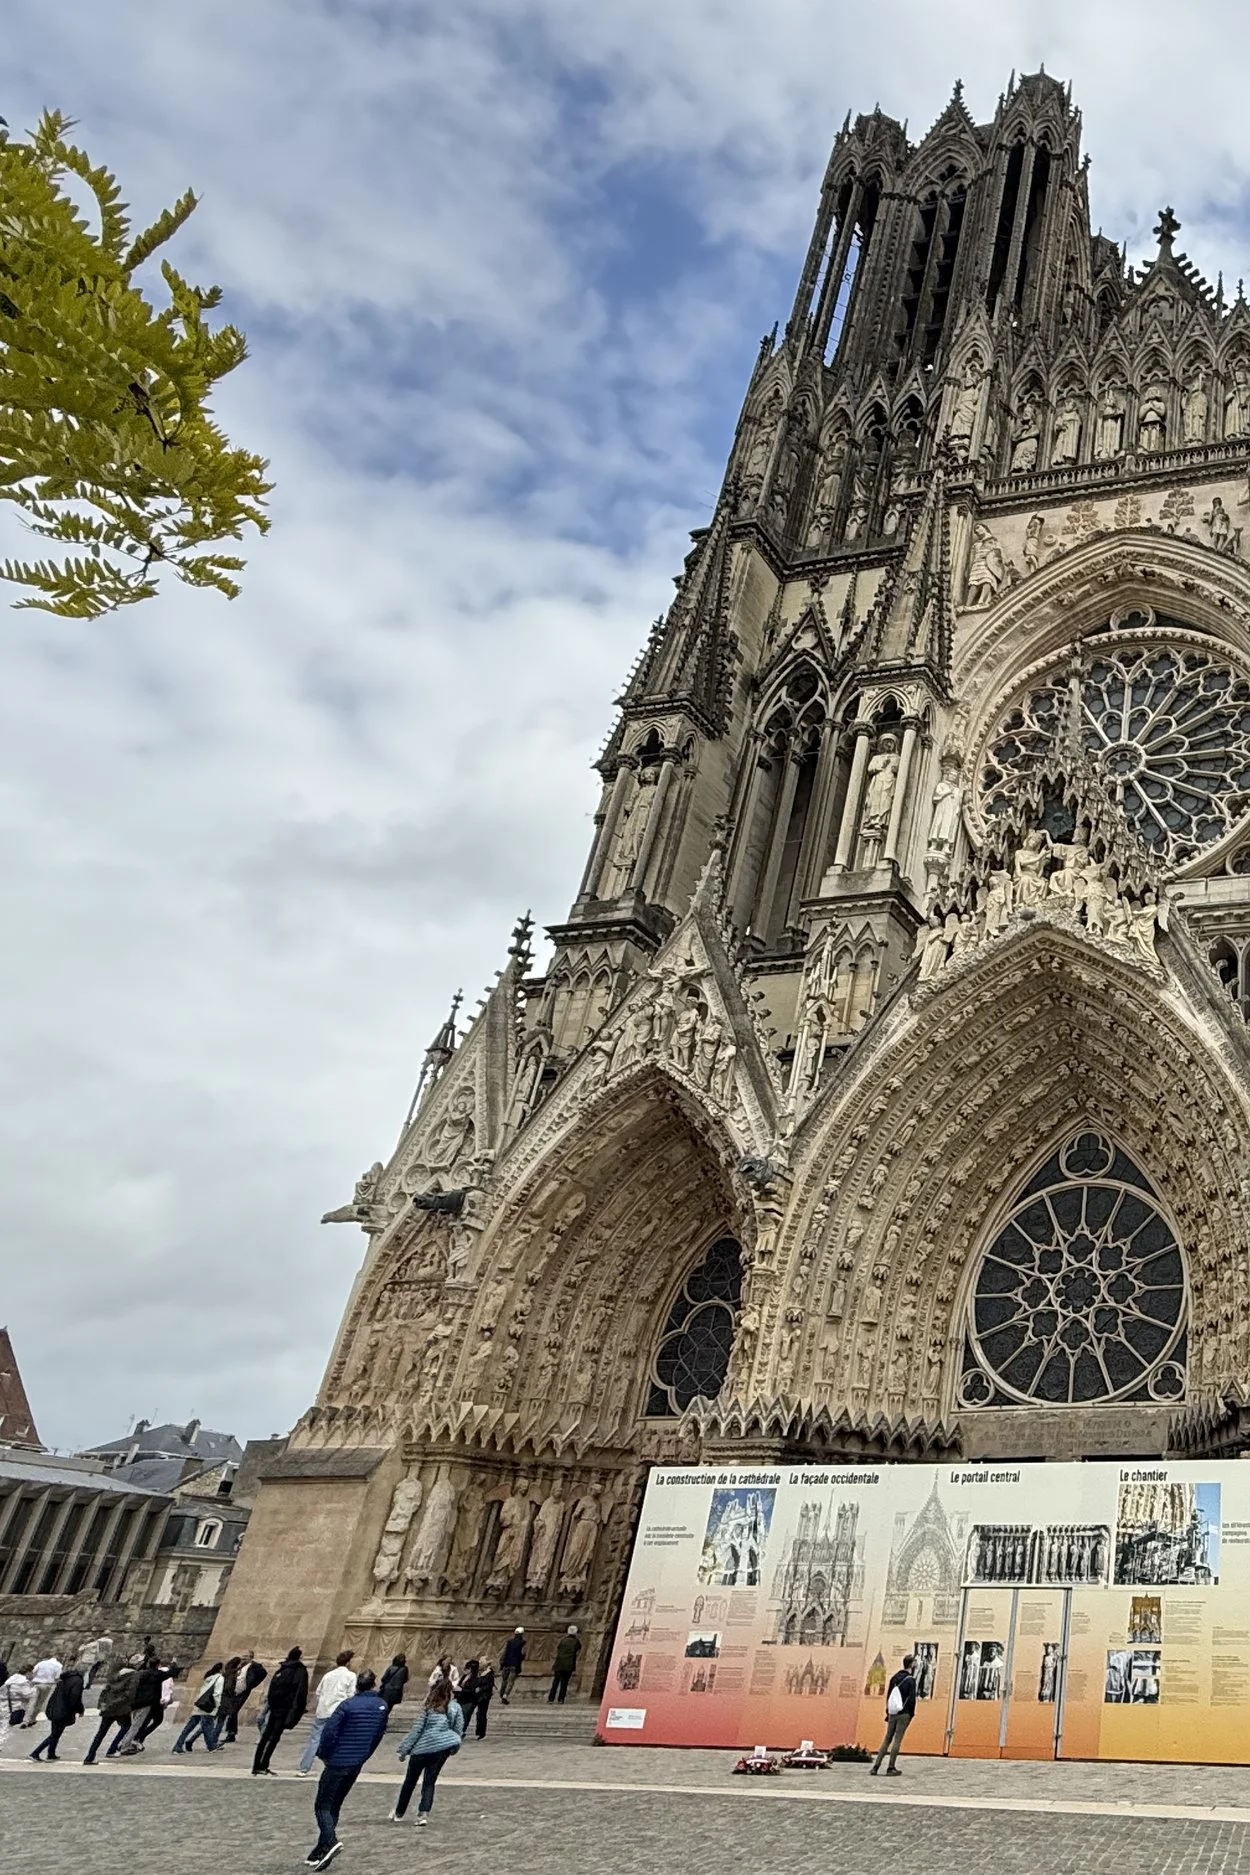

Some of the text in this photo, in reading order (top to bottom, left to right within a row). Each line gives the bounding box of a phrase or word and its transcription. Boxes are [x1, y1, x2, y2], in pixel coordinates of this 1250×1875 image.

[656, 1472, 781, 1486] La construction de la cathédrale
[789, 1472, 880, 1487] La façade occidentale
[951, 1470, 1021, 1485] Le portail central
[1120, 1468, 1168, 1481] Le chantier
